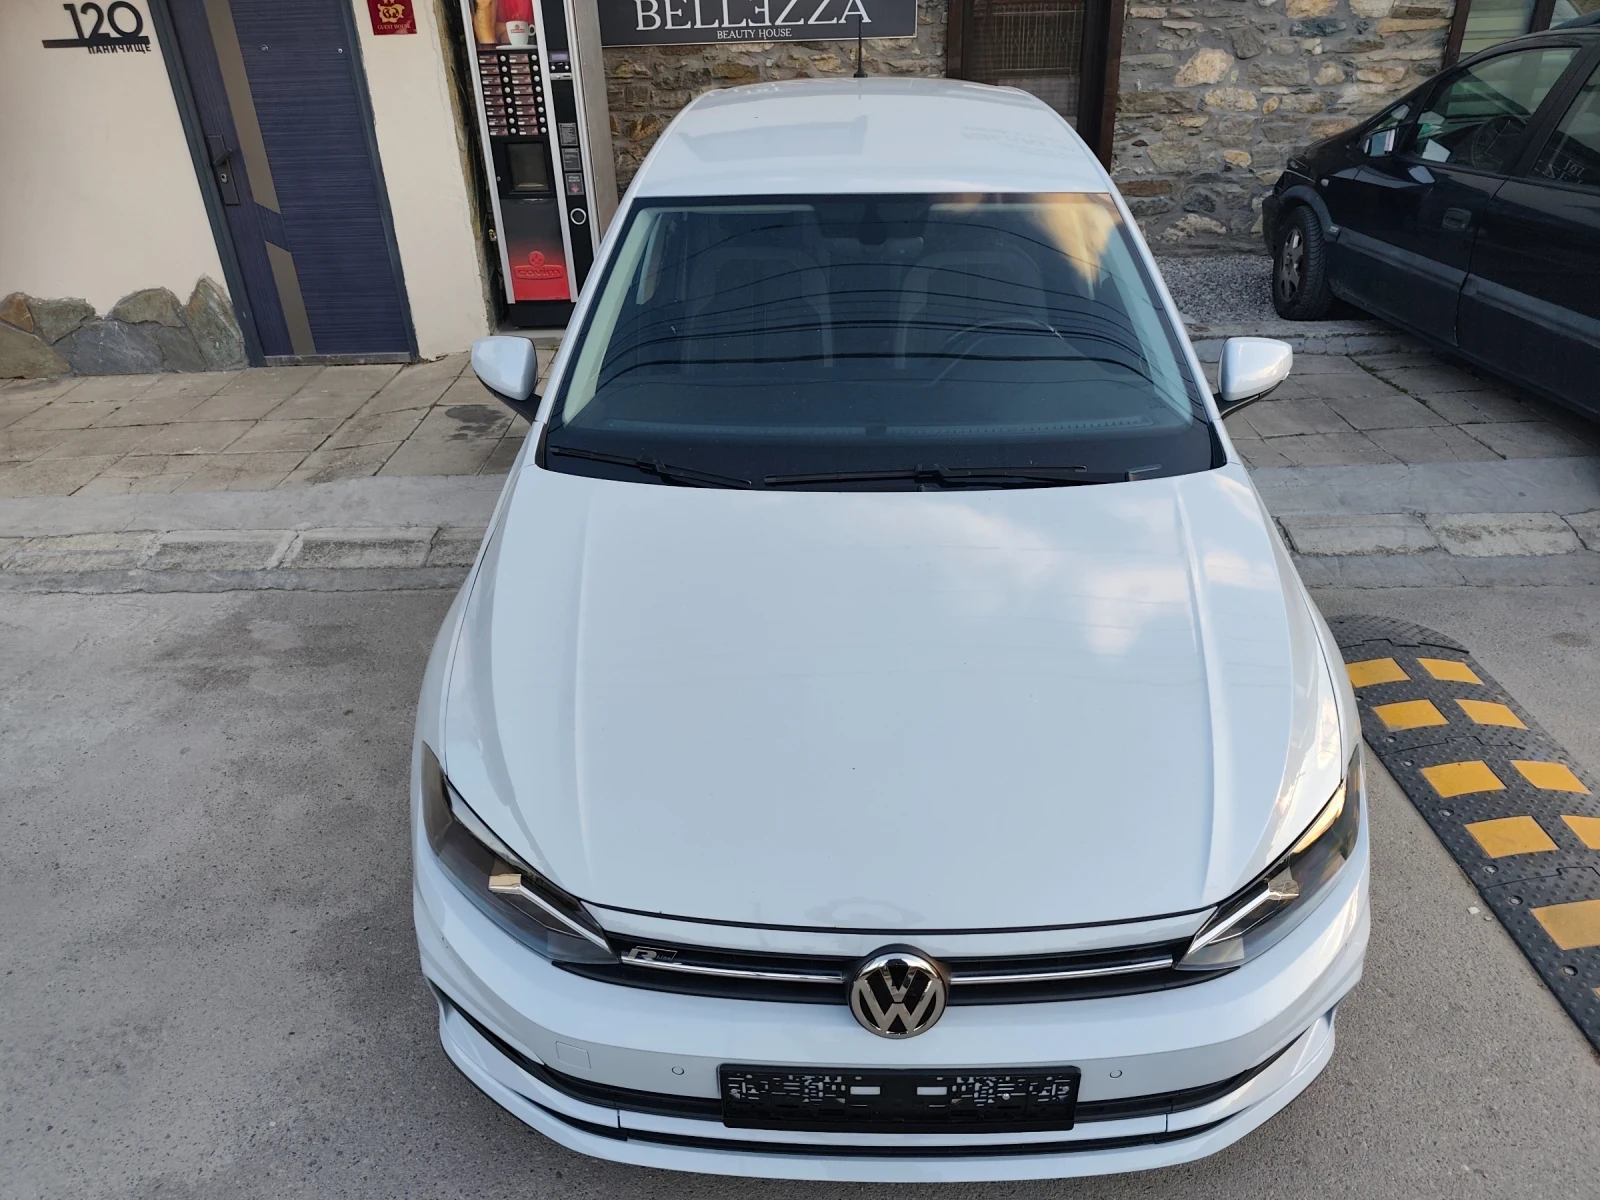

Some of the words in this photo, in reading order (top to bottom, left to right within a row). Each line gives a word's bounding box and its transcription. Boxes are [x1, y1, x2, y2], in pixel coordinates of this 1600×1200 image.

[63, 1, 144, 40] 120
[717, 29, 756, 40] BEAUTY
[758, 28, 792, 39] HOUSE
[88, 44, 151, 54] ПАНИЧИЩЕ
[517, 267, 561, 277] covim
[627, 948, 657, 961] R
